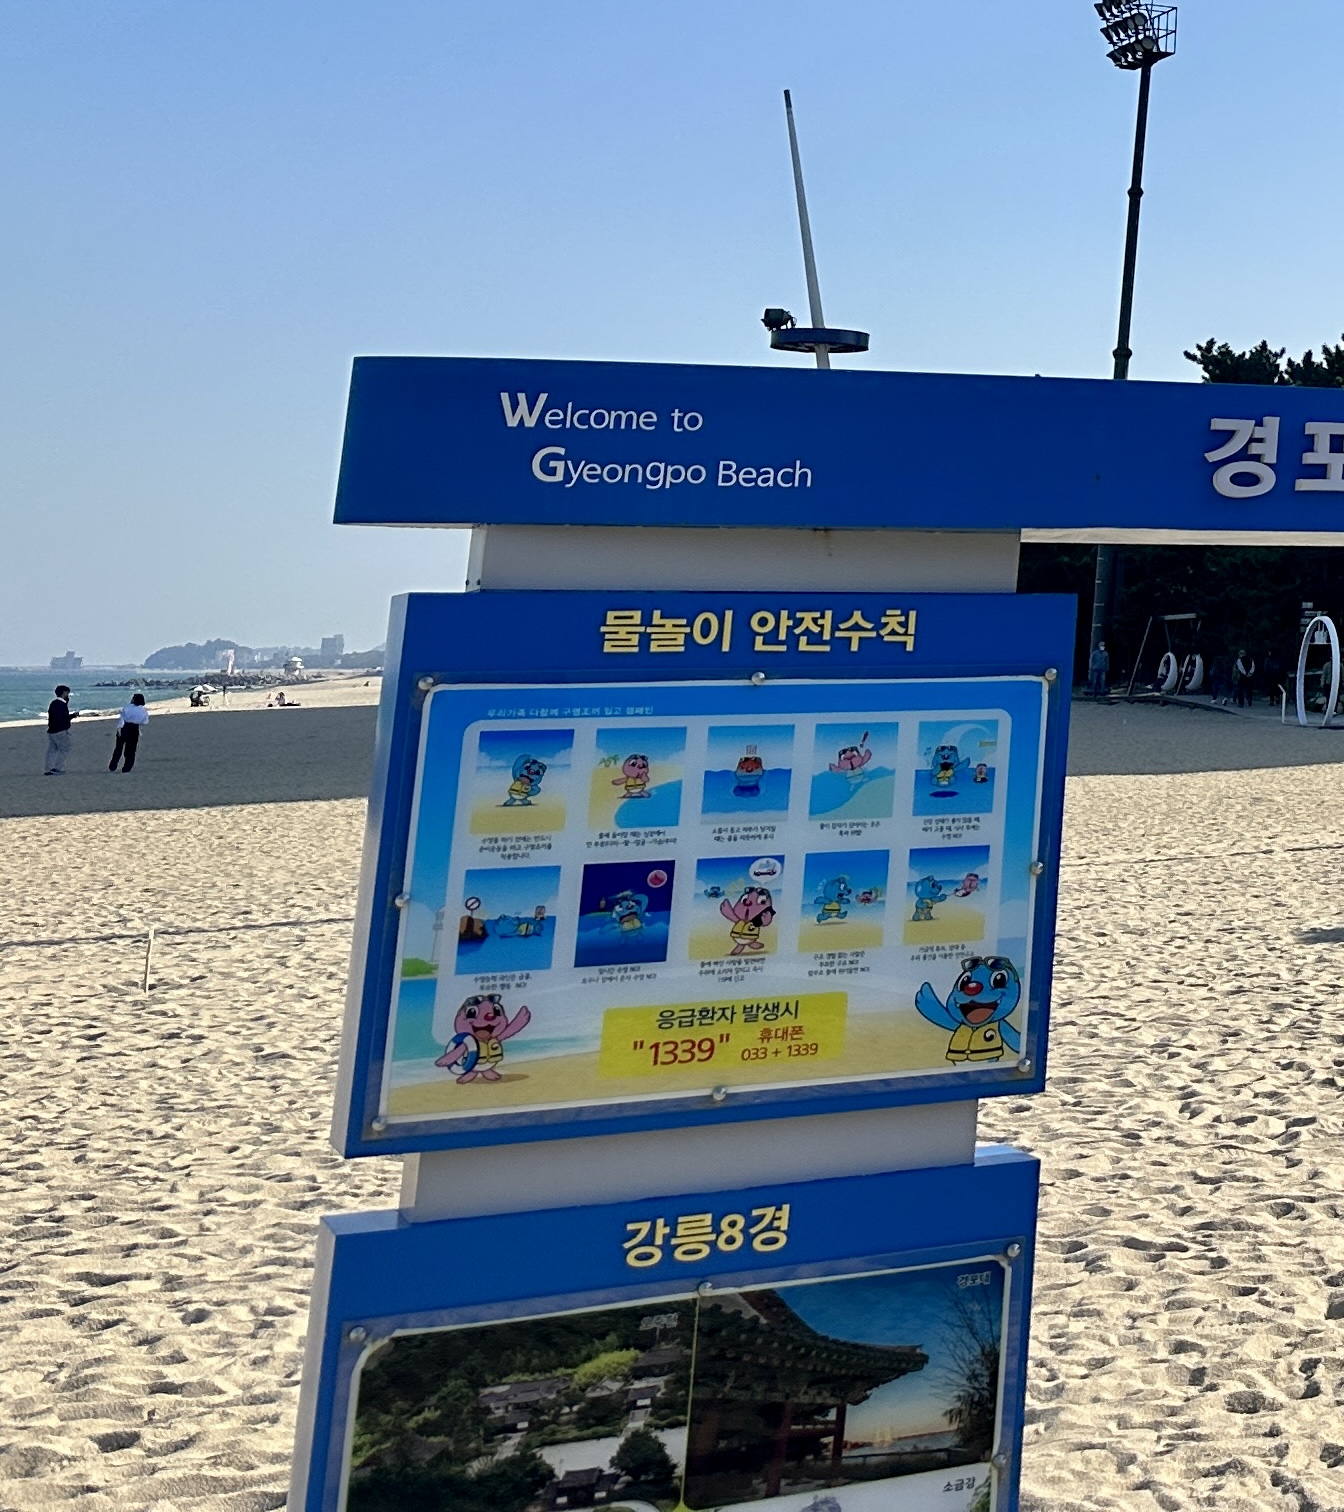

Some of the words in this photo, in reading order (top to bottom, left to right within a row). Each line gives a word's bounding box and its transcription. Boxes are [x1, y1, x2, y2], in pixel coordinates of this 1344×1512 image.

[499, 391, 659, 432] Welcome
[671, 405, 704, 433] to
[530, 445, 709, 490] Gyeongpo
[717, 457, 813, 490] Beach
[599, 608, 733, 654] 물놀이
[749, 608, 920, 652] 안전수칙
[655, 1004, 736, 1031] 응급환자
[742, 999, 800, 1024] 발생시
[741, 1046, 768, 1062] 033
[786, 1042, 819, 1059] 1339
[757, 1024, 805, 1044] 휴대폰
[622, 1203, 791, 1269] 강릉8경
[942, 1475, 976, 1492] 소금강
